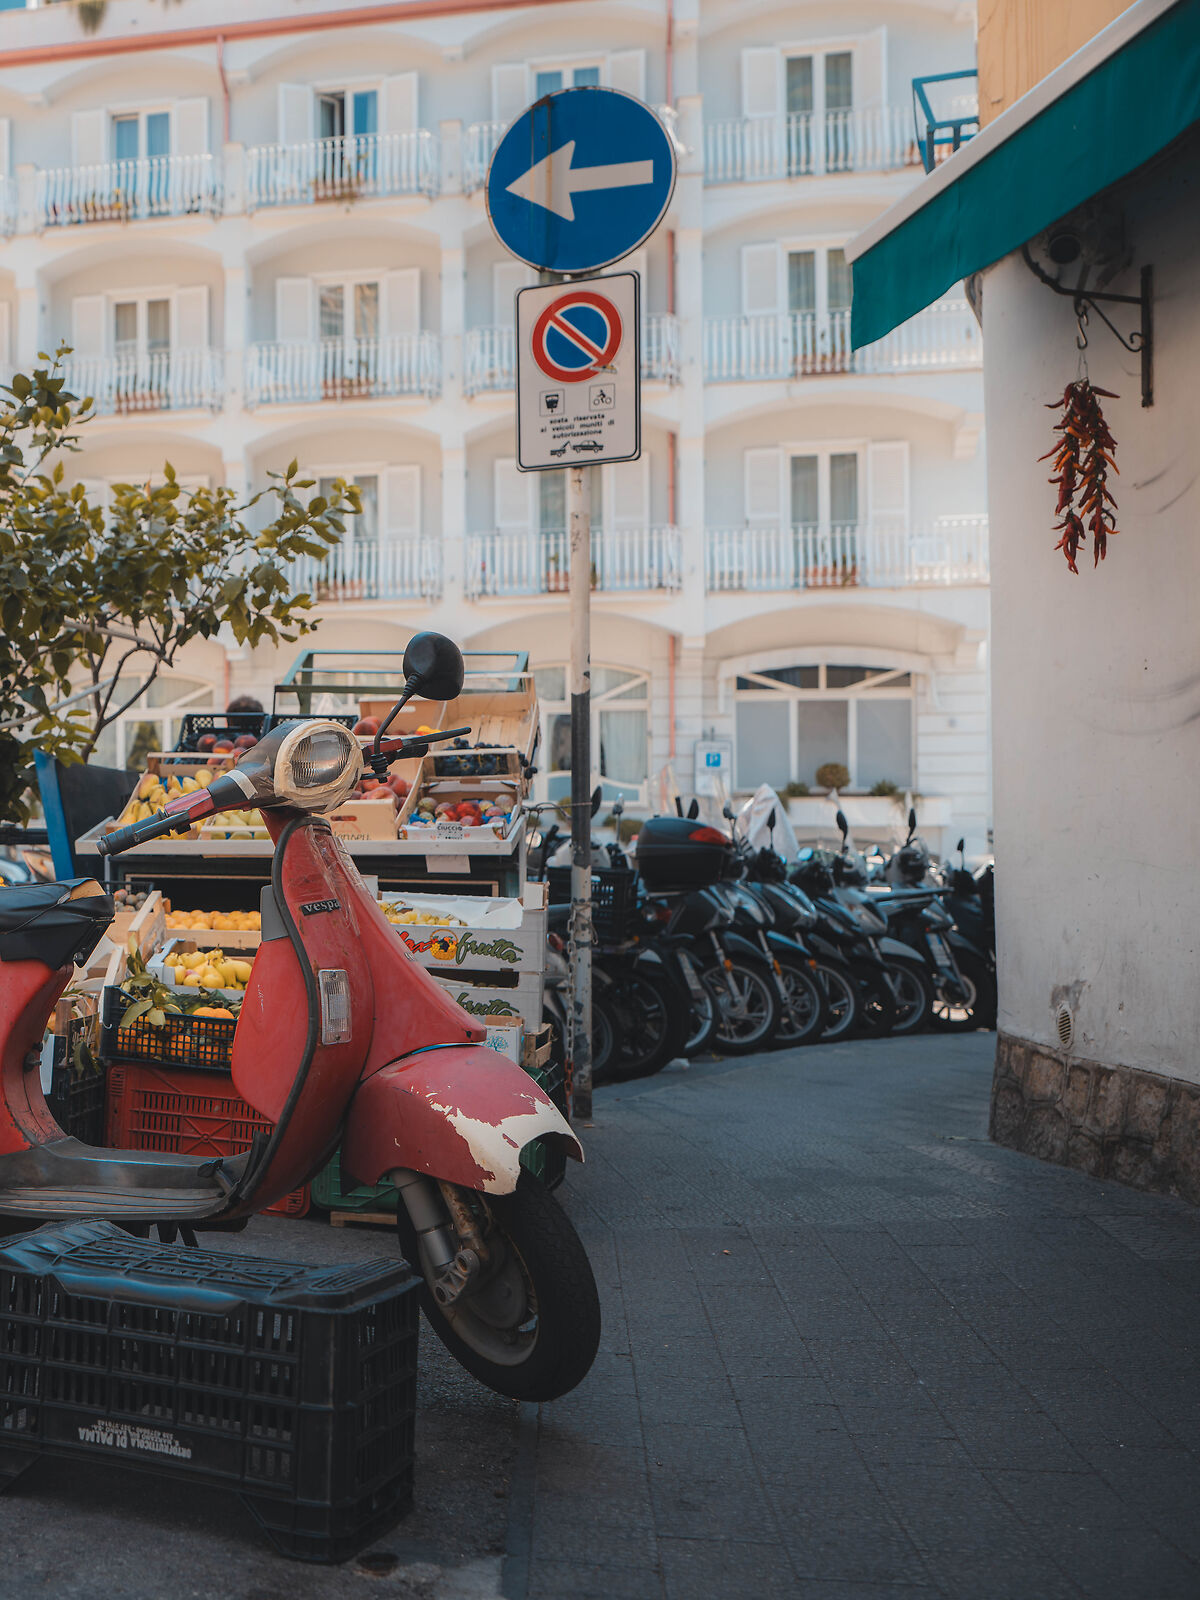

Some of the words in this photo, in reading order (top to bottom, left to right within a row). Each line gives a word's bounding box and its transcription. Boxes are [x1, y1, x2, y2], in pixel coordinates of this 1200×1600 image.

[549, 417, 568, 425] sosta
[574, 414, 605, 422] riservata
[579, 421, 603, 429] muniti
[552, 429, 602, 439] autorizzazione
[304, 900, 341, 912] vespa
[456, 932, 524, 965] frutta
[78, 1427, 114, 1447] PALMA
[115, 1433, 128, 1449] DI
